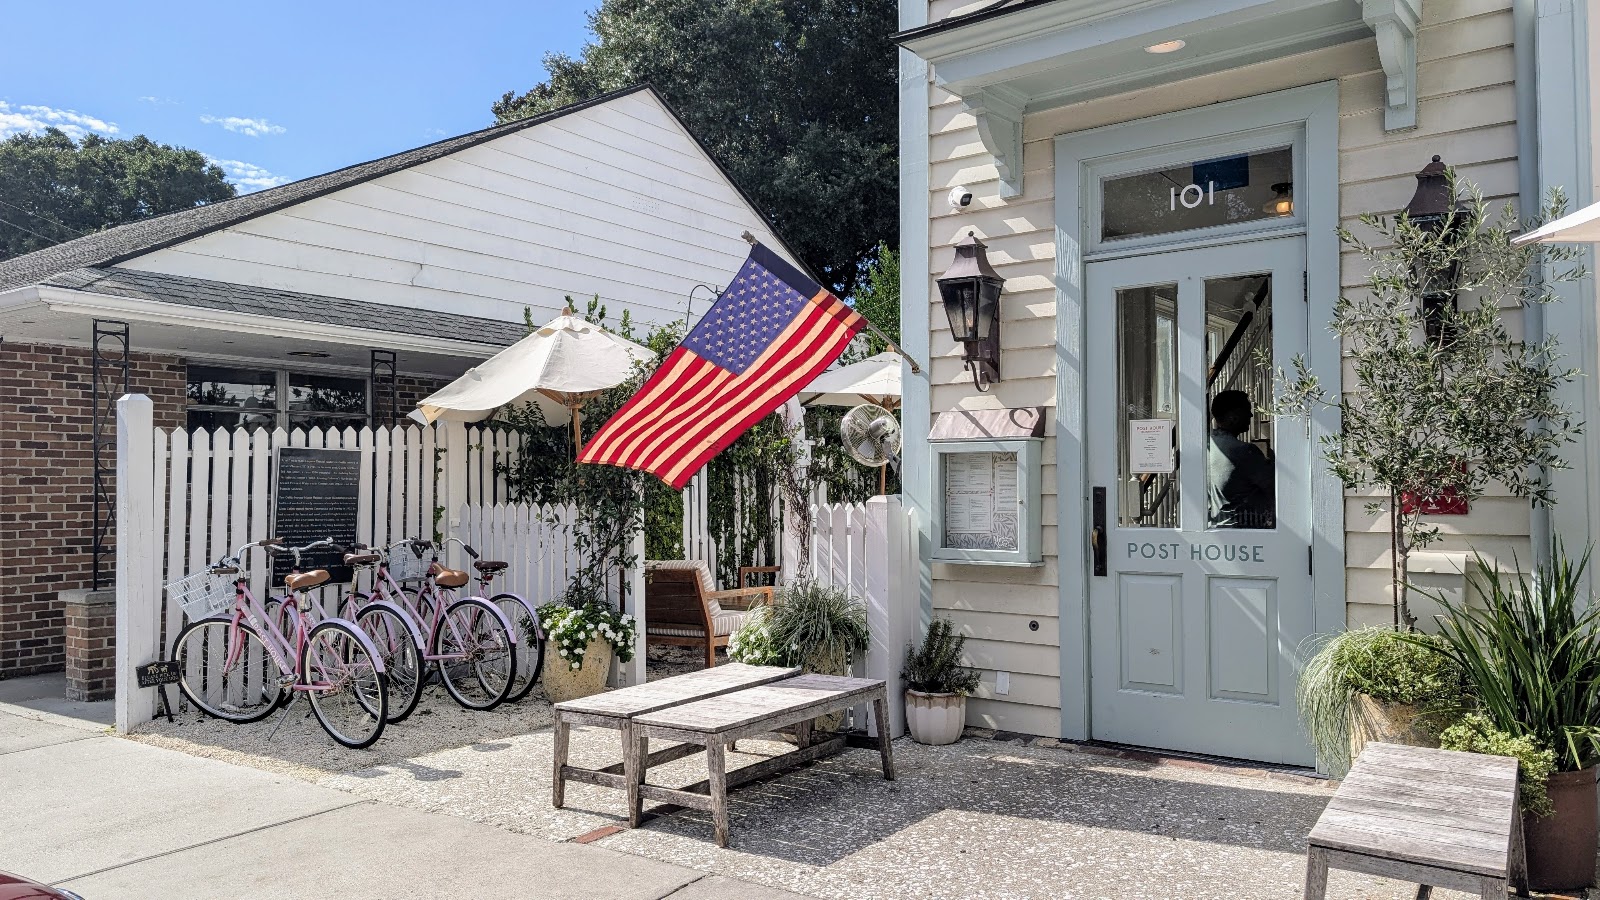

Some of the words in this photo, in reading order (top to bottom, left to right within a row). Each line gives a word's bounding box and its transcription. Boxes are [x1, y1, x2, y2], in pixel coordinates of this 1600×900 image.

[1170, 180, 1214, 211] 101
[1127, 542, 1180, 560] POST
[1190, 544, 1265, 563] HOUSE
[253, 622, 268, 644] POST
[267, 644, 287, 671] HOUSE
